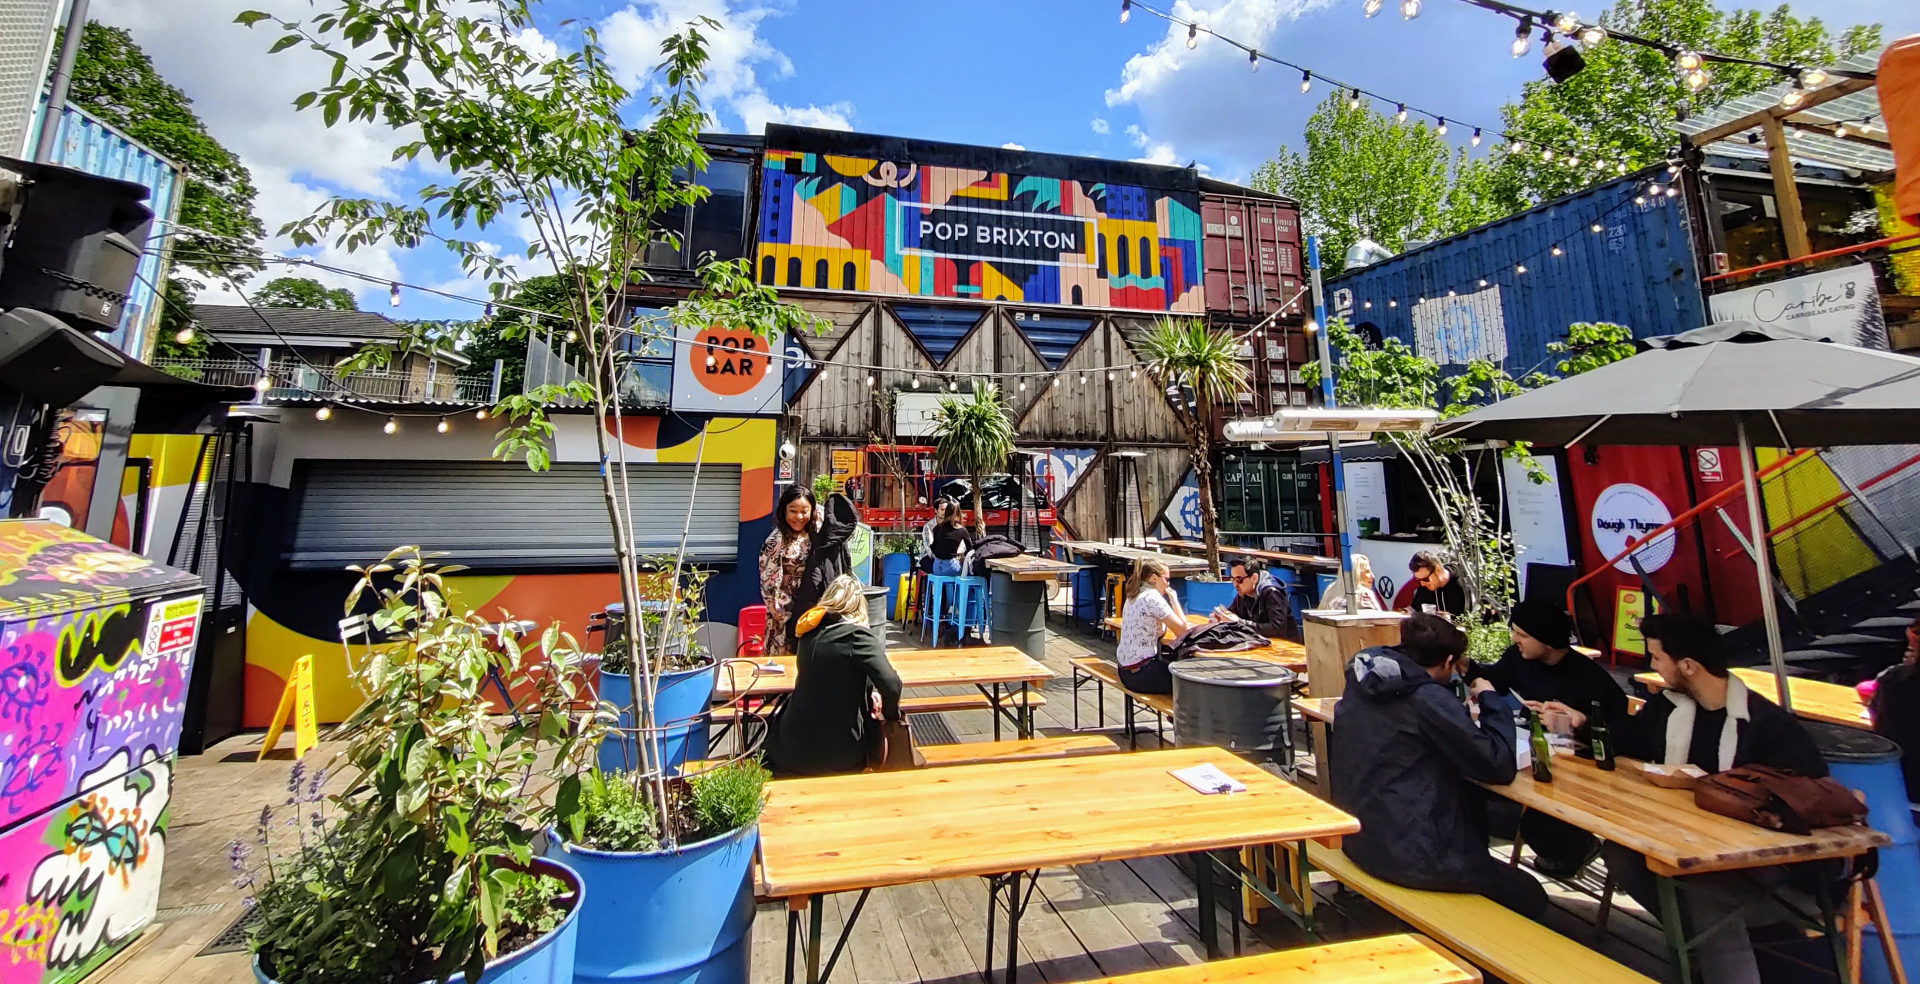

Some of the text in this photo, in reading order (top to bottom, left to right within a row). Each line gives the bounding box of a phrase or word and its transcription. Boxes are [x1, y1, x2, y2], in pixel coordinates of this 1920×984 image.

[920, 221, 1075, 250] POP BRIXTON
[1786, 303, 1856, 321] CARRIBEAN EATING
[706, 335, 757, 355] POP
[705, 357, 753, 376] BAR
[1225, 472, 1262, 482] CAPTAL
[1596, 518, 1626, 533] Dough
